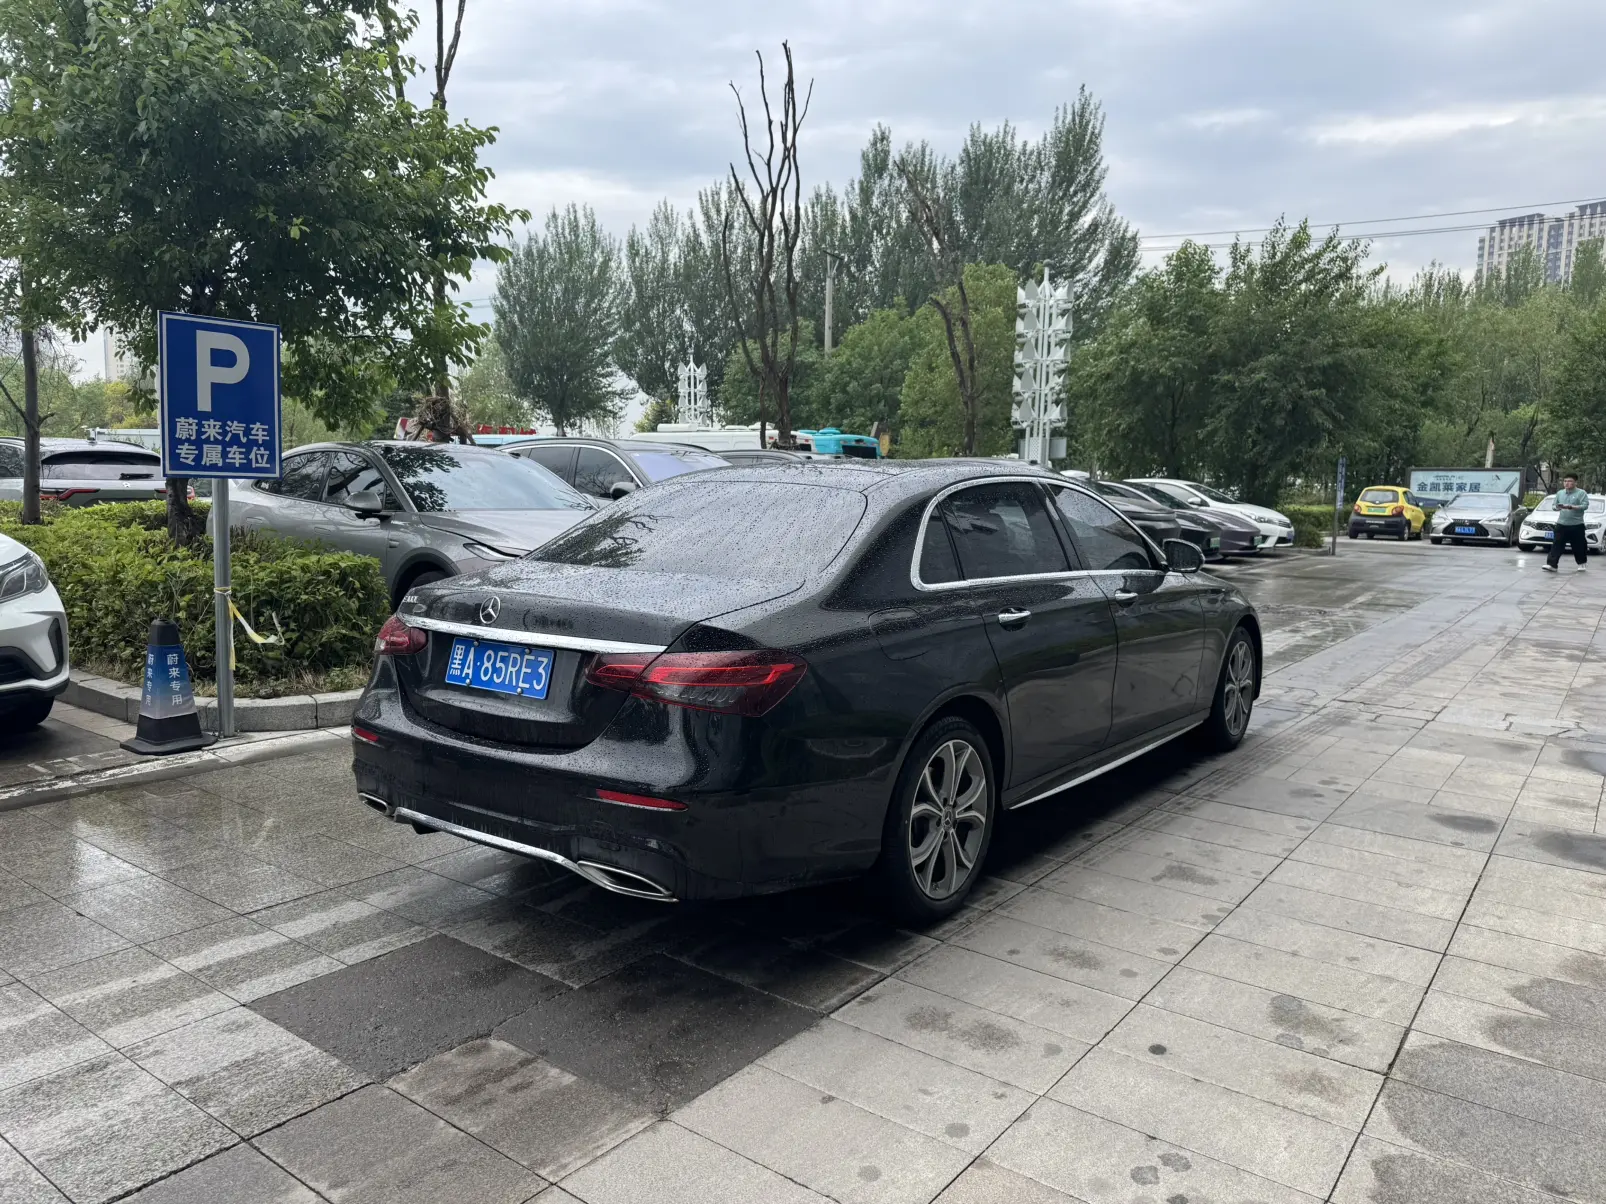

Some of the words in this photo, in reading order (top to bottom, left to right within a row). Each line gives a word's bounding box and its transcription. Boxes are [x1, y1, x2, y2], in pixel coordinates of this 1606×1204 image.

[196, 330, 250, 412] P
[175, 417, 270, 444] 蔚来汽车
[175, 442, 271, 468] 专属车位
[1417, 481, 1481, 492] 金凯莱家居
[166, 653, 183, 706] 蔚来专用
